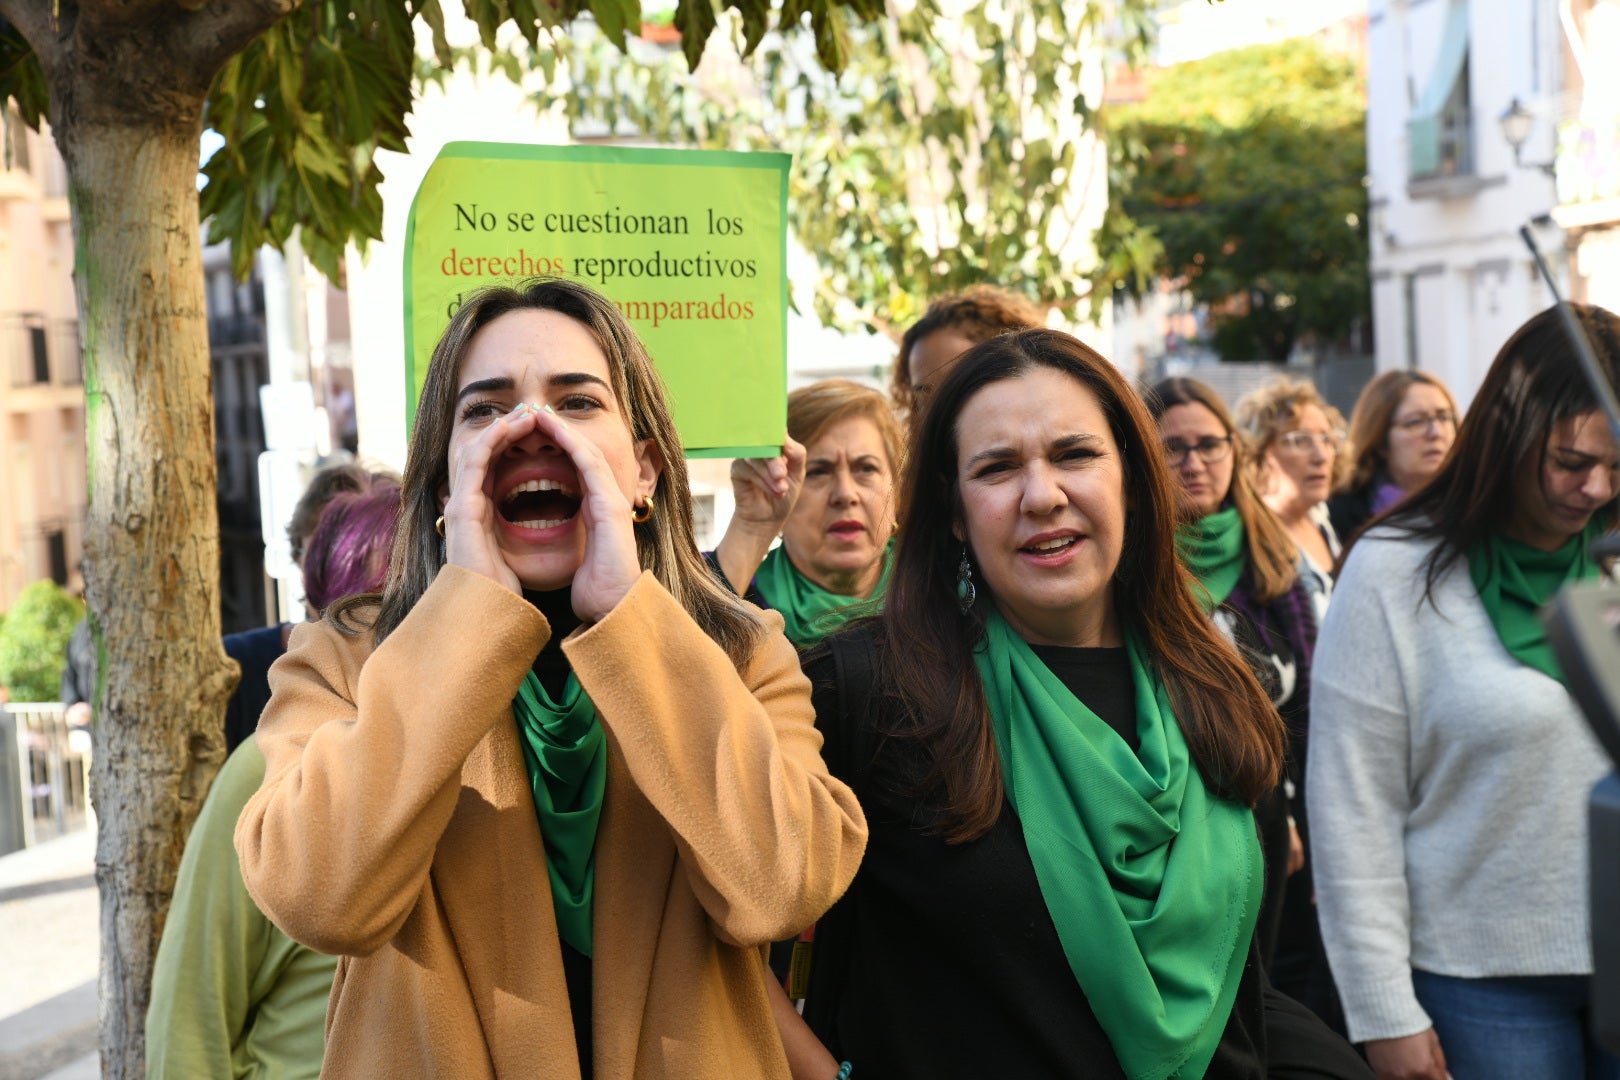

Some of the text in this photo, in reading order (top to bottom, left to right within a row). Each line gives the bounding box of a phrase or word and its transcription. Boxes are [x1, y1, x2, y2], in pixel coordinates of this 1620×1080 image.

[453, 203, 744, 236] No se cuestionan los
[441, 248, 757, 285] derechos reproductivos
